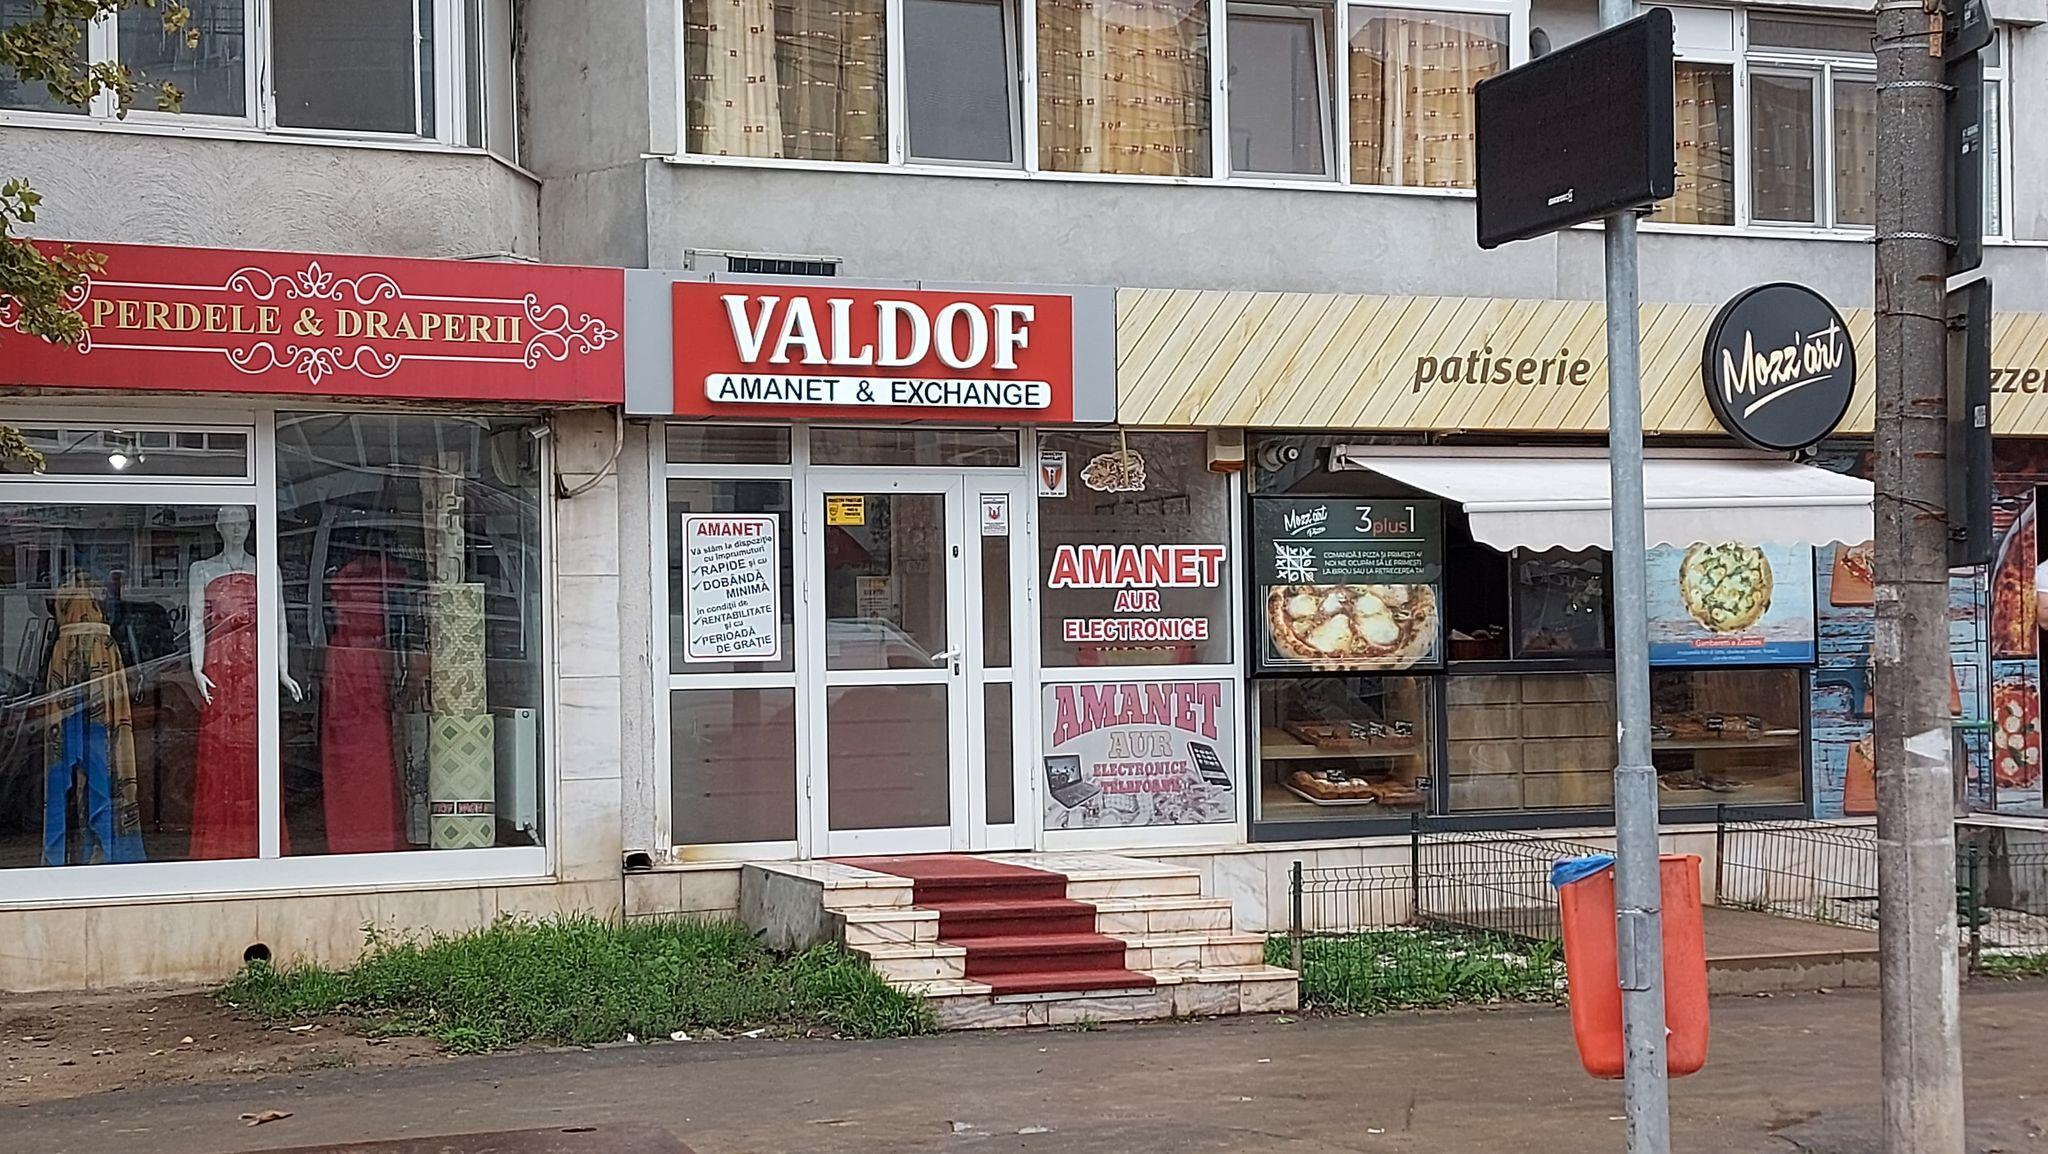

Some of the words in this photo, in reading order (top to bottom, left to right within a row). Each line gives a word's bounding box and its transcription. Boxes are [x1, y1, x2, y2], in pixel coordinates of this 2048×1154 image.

[91, 298, 282, 335] PERDELE
[293, 306, 325, 337] &
[336, 308, 522, 345] DRAPERII
[719, 293, 1036, 370] VALDOF
[1413, 346, 1591, 394] patiserie
[719, 376, 841, 402] AMANET
[856, 380, 876, 402] &
[891, 380, 1041, 406] EXCHANGE
[697, 522, 763, 536] AMANET
[701, 559, 746, 576] RAPIDE
[1049, 546, 1225, 587] AMANET
[1115, 590, 1160, 611] AUR
[701, 605, 772, 625] RENTABILITATE
[1064, 619, 1208, 641] ELECTRONICE
[716, 643, 731, 653] DE
[1053, 682, 1222, 747] AMANET
[1108, 731, 1173, 759] AUR
[1093, 761, 1187, 777] ELECTRONICE
